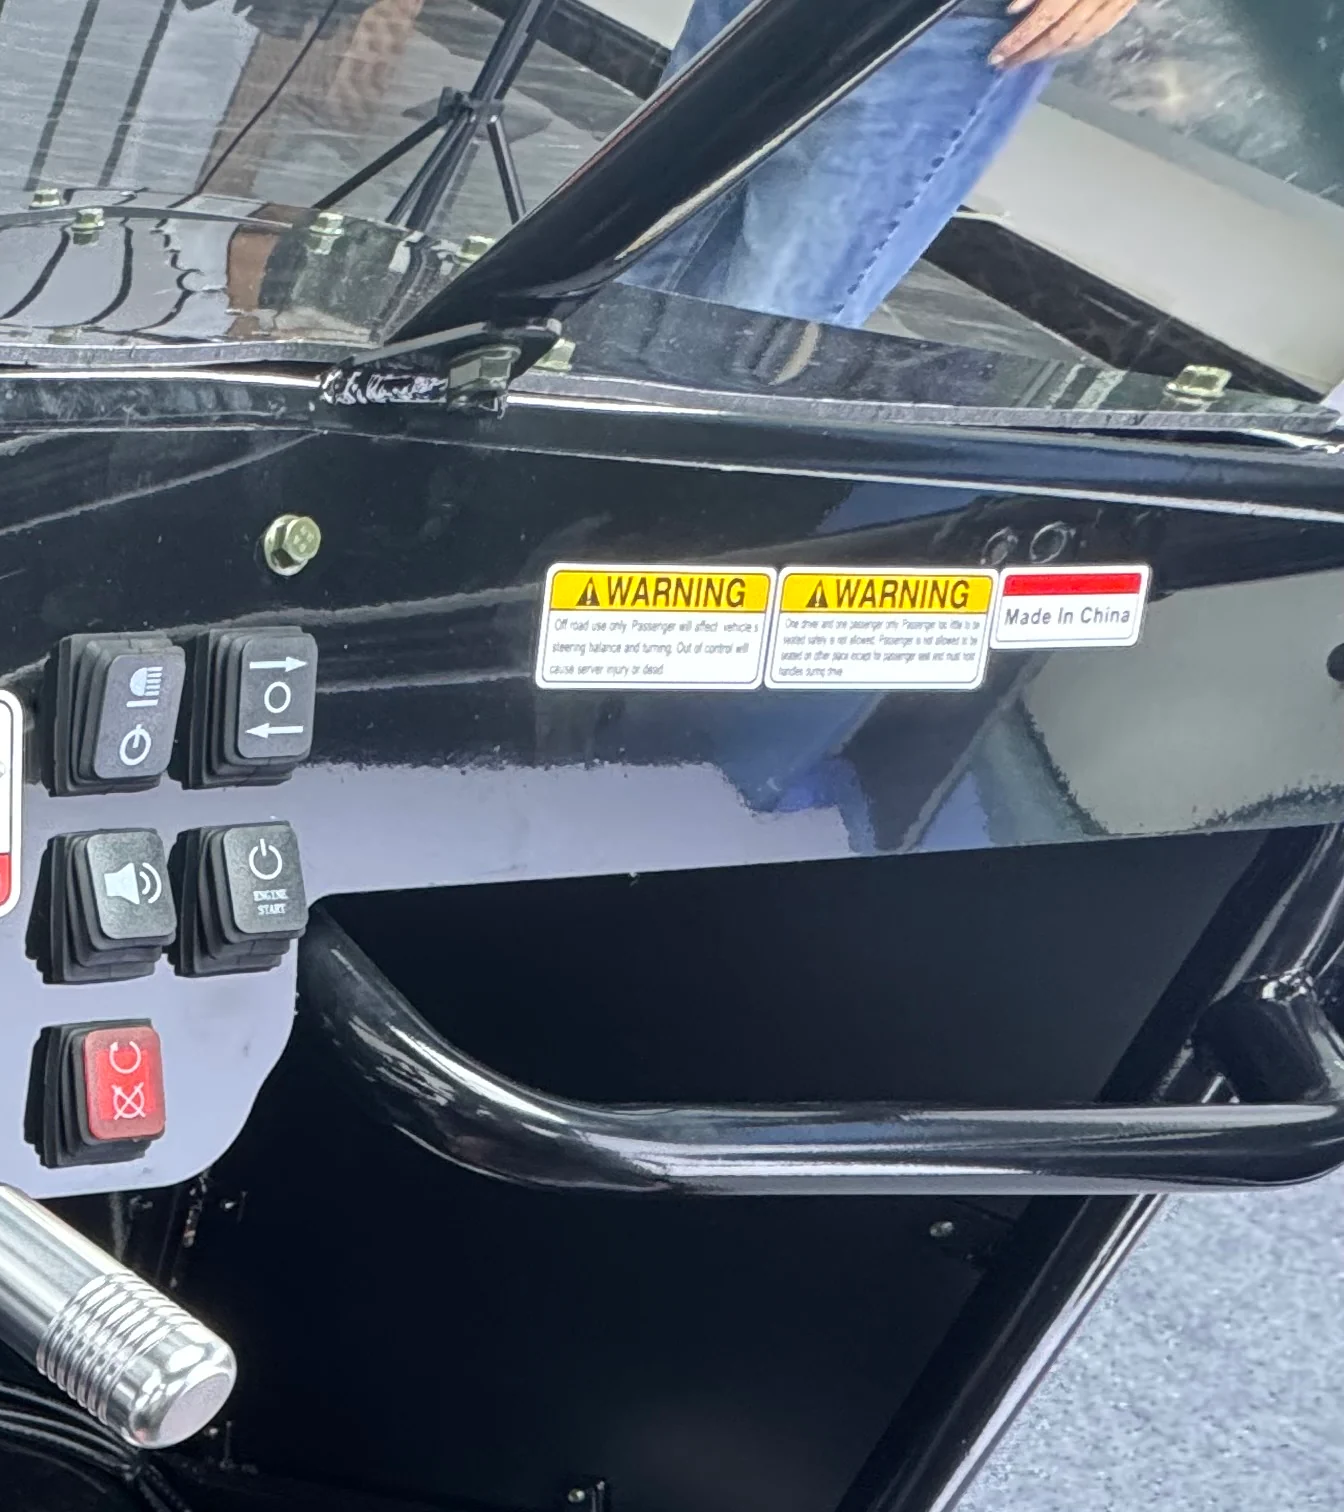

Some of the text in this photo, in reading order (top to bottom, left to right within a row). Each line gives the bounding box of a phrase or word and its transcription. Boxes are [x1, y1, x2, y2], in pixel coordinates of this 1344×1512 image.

[607, 575, 746, 608] WARNING
[835, 578, 970, 609] WARNING
[1004, 606, 1131, 625] Made In China
[570, 619, 590, 631] road
[592, 622, 607, 631] use
[632, 619, 677, 636] Passenger
[552, 642, 586, 656] steering
[589, 641, 622, 653] balance
[624, 641, 640, 653] and
[676, 641, 692, 654] Out
[704, 642, 734, 655] control
[257, 903, 286, 915] START
